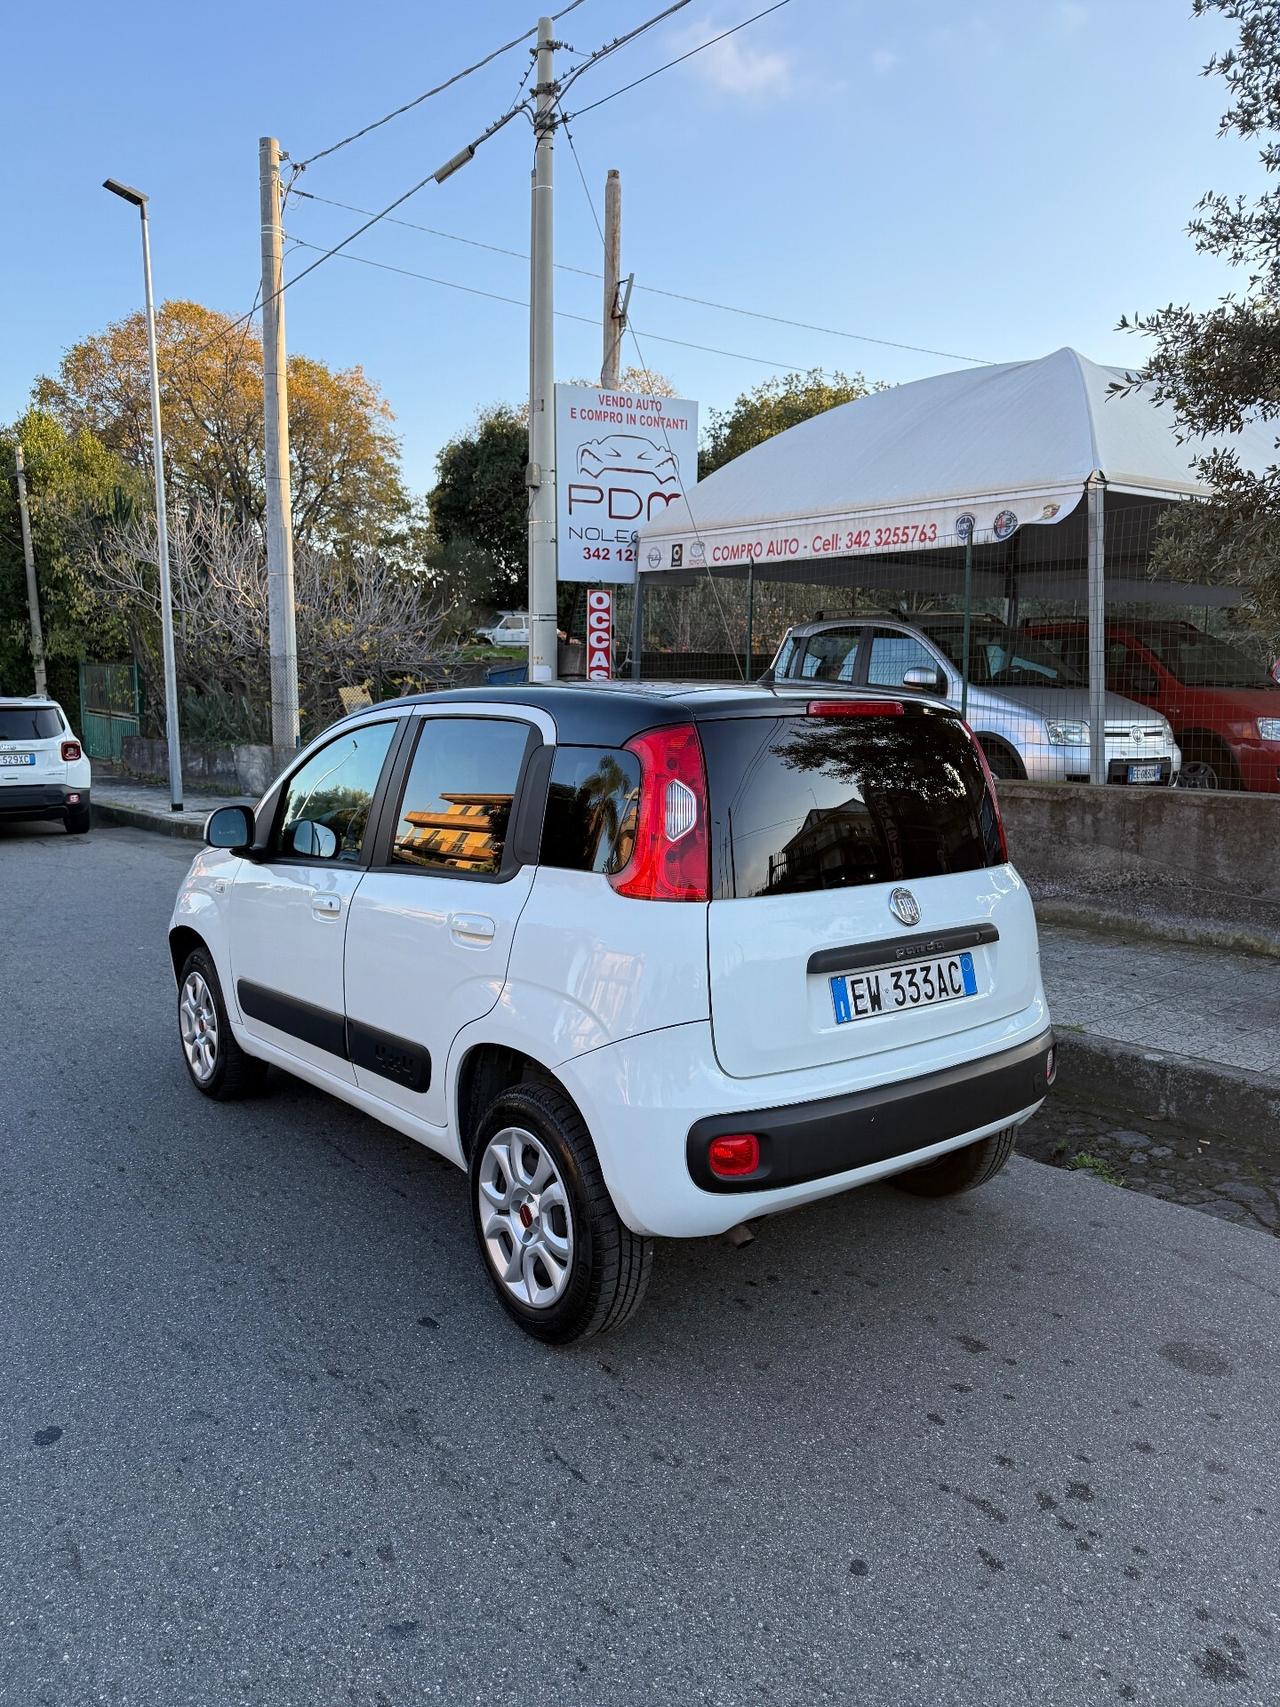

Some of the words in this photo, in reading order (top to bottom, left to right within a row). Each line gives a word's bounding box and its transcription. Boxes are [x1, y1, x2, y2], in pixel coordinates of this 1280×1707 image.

[598, 394, 633, 409] VENDO
[636, 399, 662, 412] AUTO
[570, 408, 577, 419] E
[580, 408, 623, 424] COMPRO
[626, 414, 637, 425] IN
[639, 415, 688, 431] CONTANTI
[583, 547, 611, 560] 342
[712, 541, 763, 562] COMPRO
[766, 537, 799, 556] AUTO
[812, 531, 842, 552] Cell:
[845, 530, 871, 549] 342
[874, 523, 938, 547] 3255763
[850, 975, 883, 1016] EW
[890, 960, 962, 1007] 333AC
